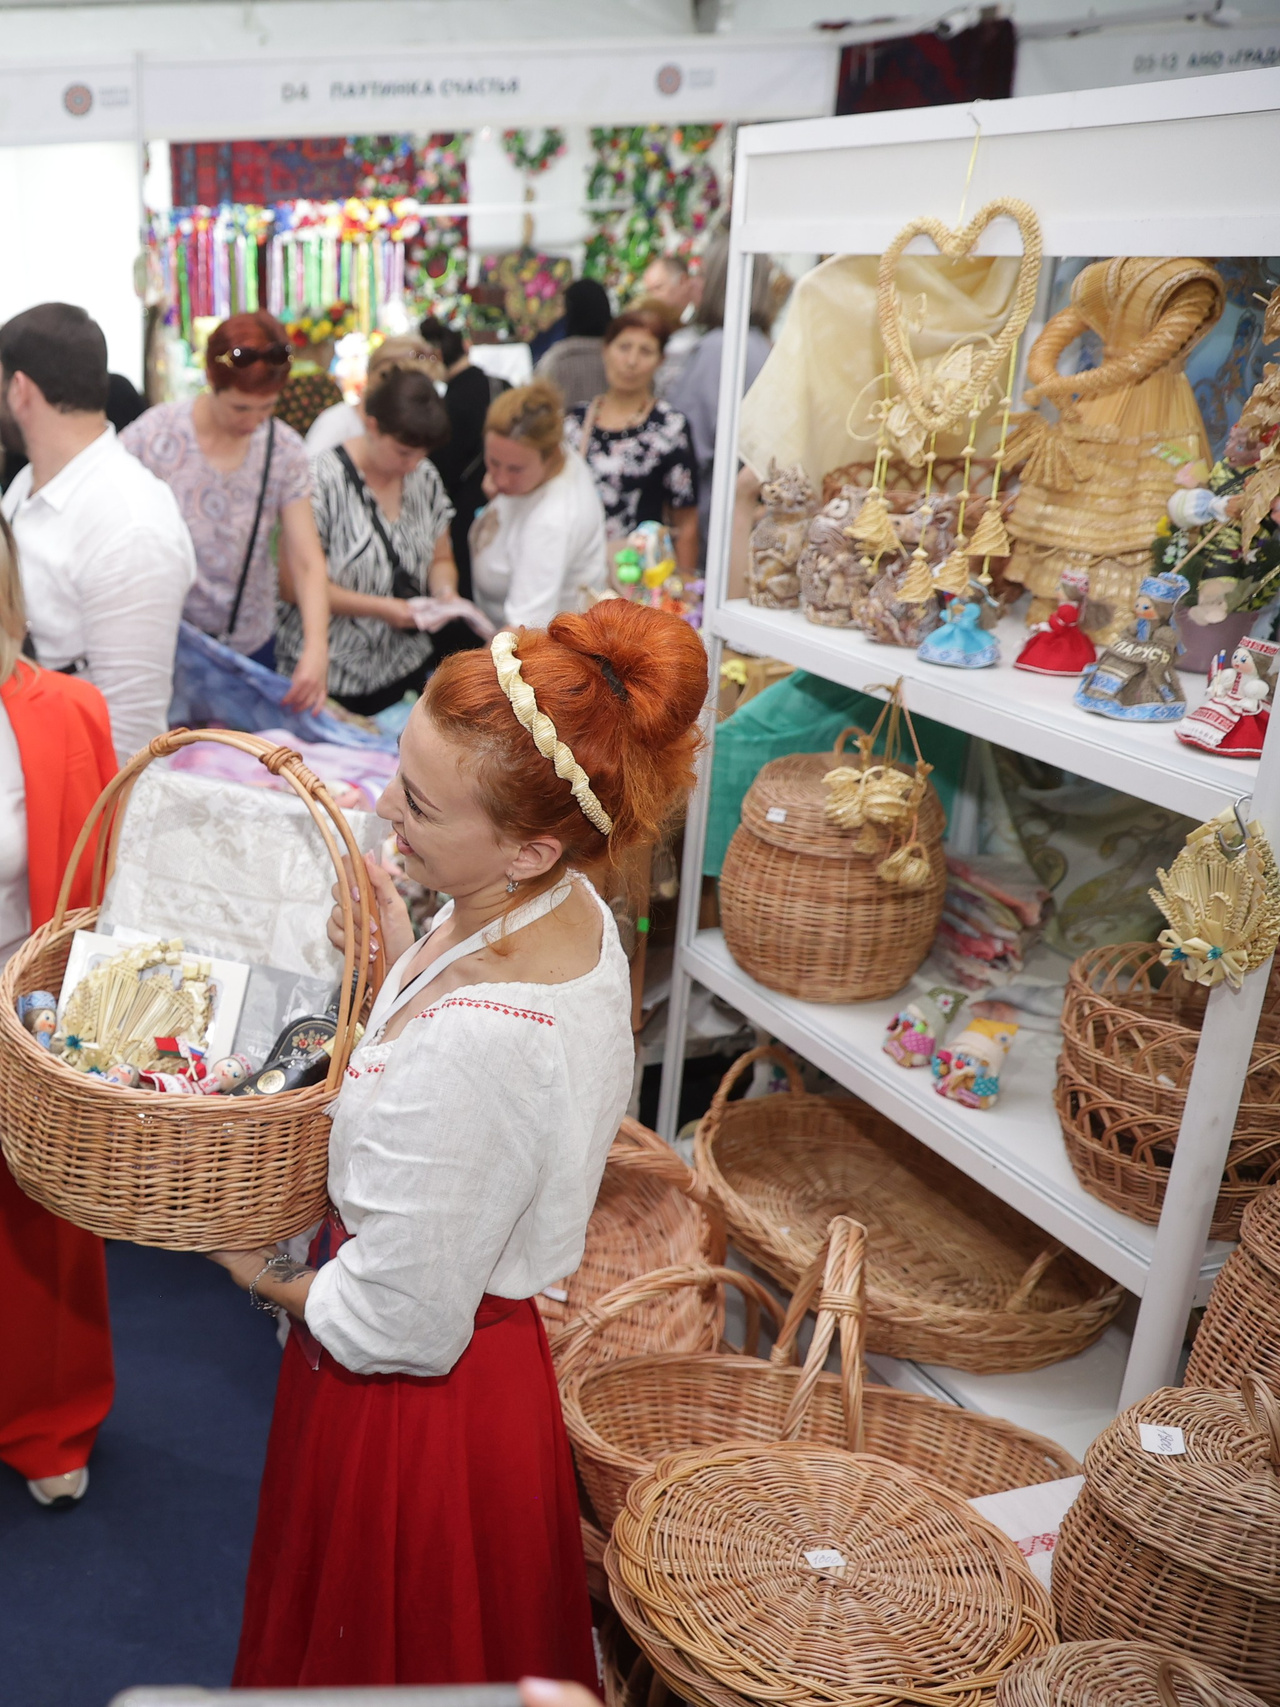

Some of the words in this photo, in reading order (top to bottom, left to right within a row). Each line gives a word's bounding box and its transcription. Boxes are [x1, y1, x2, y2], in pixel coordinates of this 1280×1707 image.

[281, 81, 310, 103] D4
[329, 78, 436, 100] ПАУТИНКА
[439, 74, 520, 98] СЧАСТЬЯ
